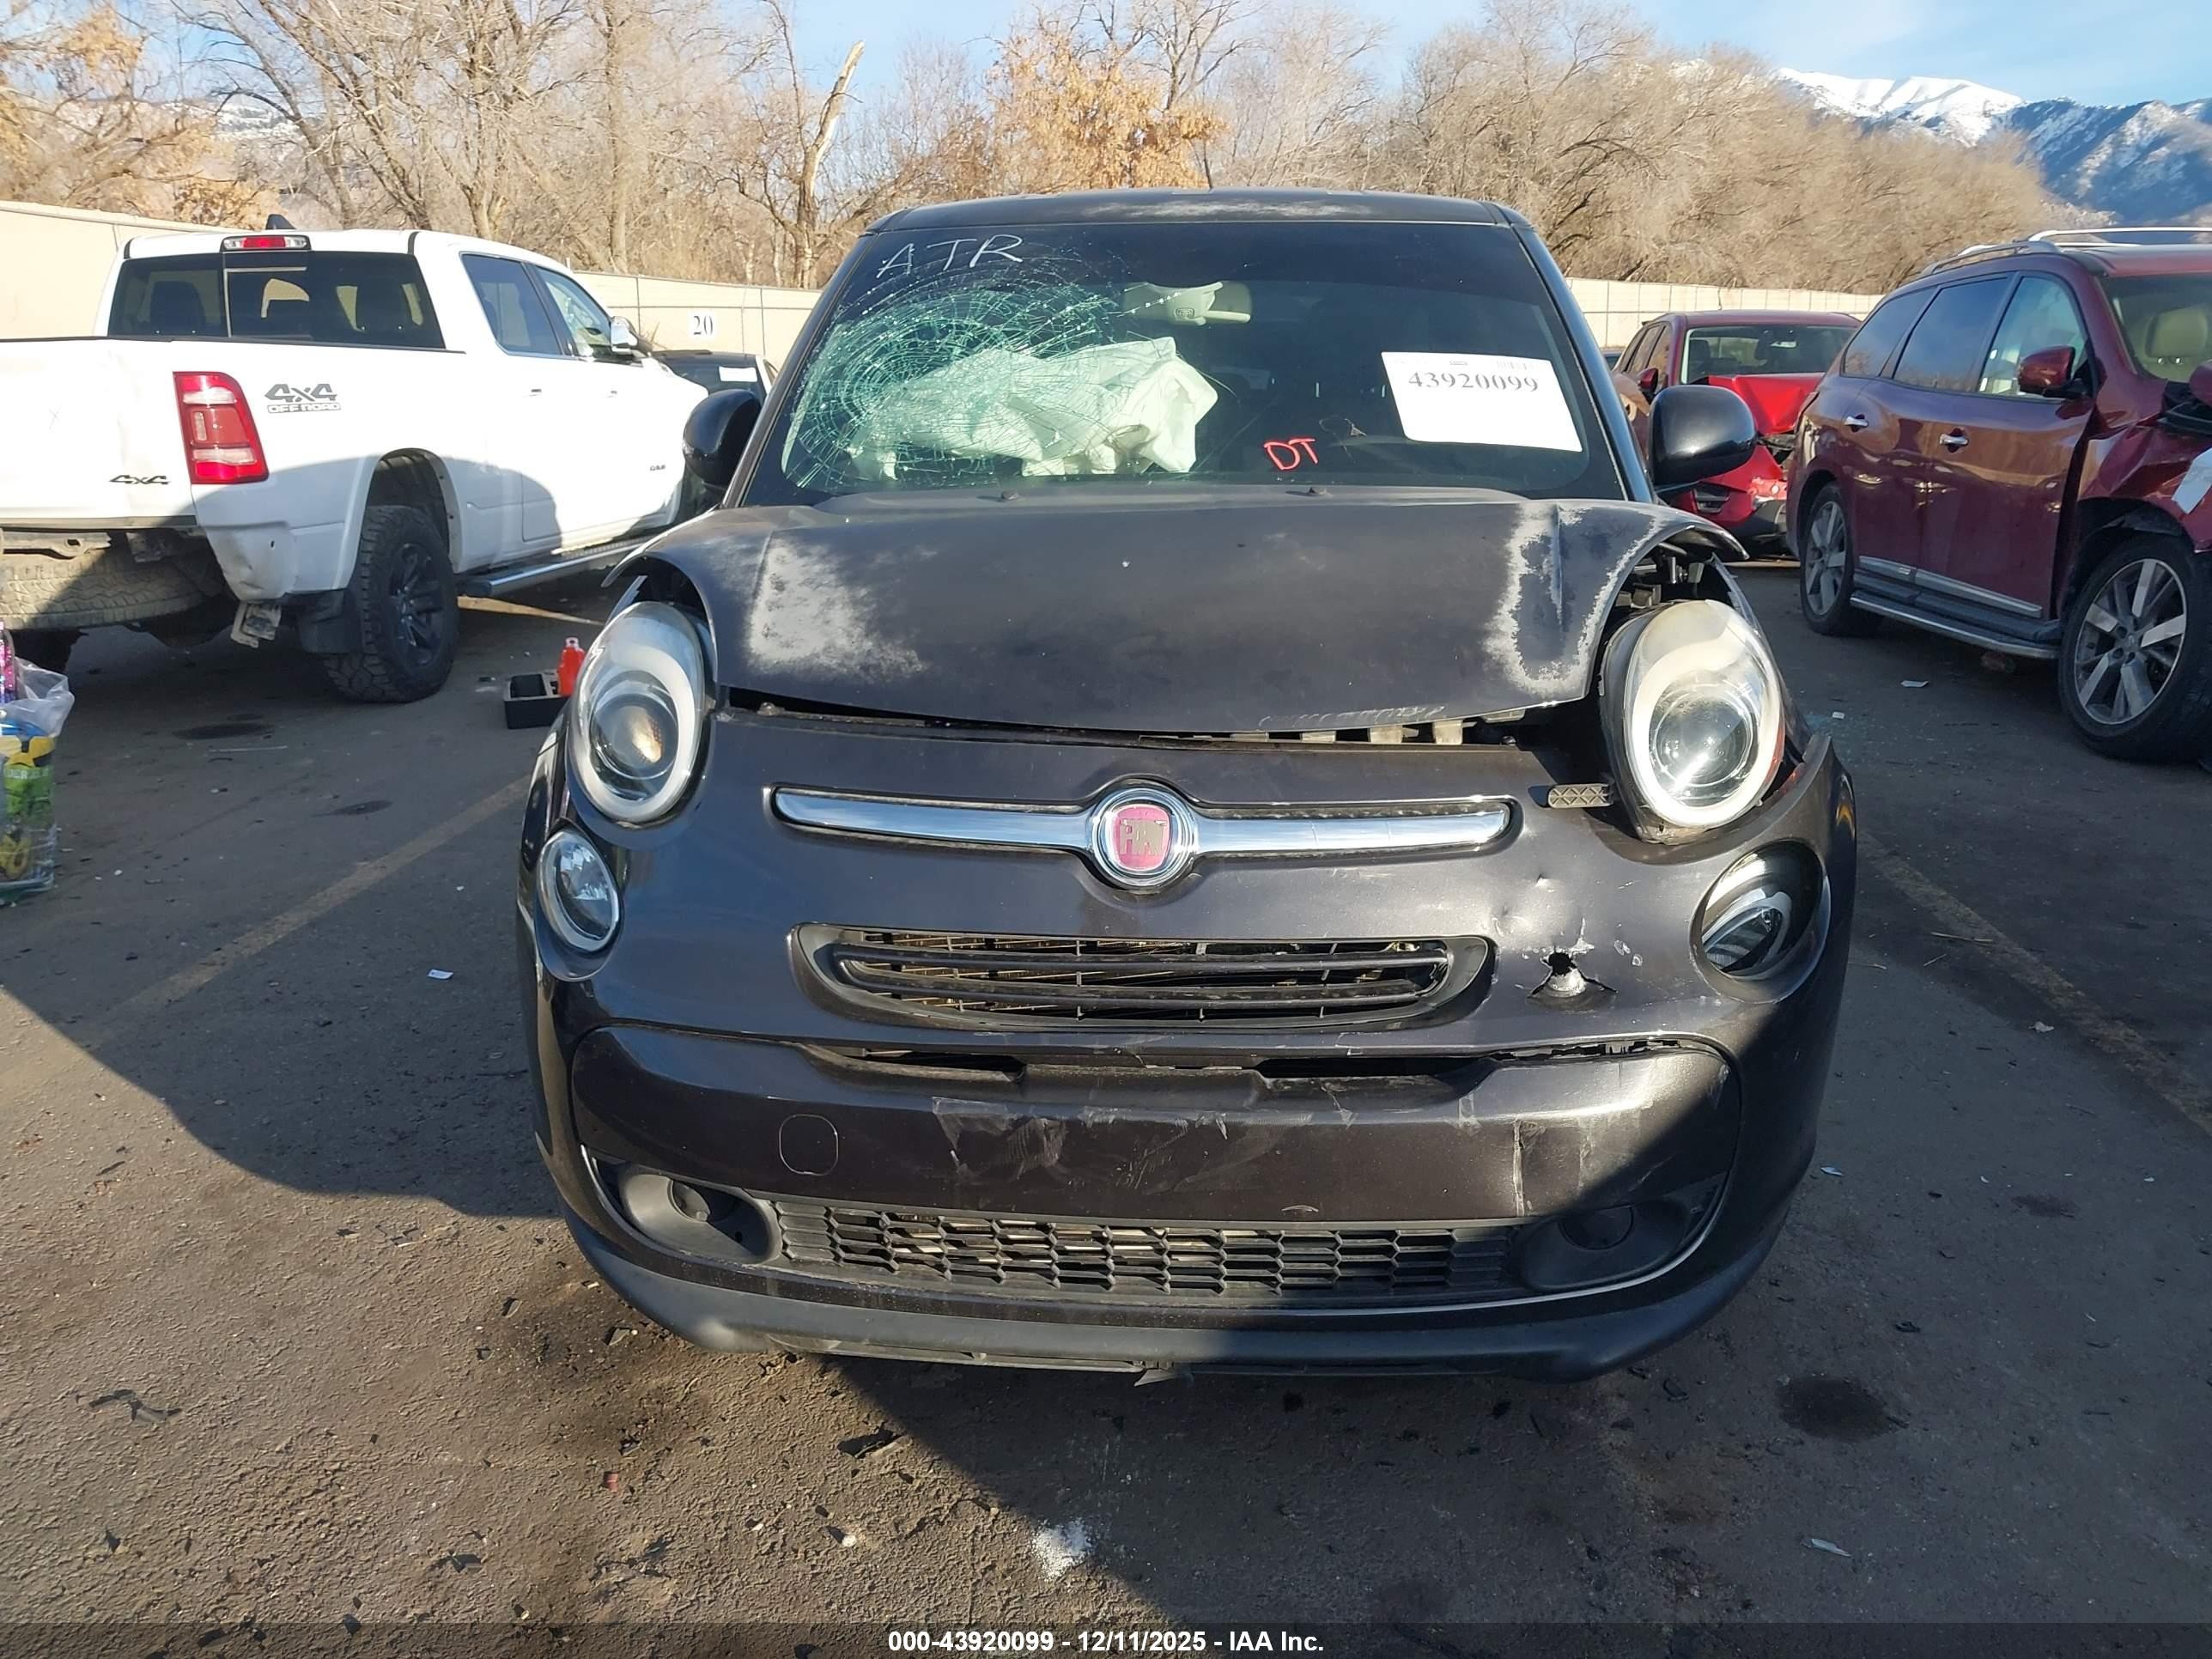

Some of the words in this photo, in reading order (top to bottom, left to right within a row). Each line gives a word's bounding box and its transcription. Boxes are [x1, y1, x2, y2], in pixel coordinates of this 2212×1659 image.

[876, 234, 1023, 278] ATR
[693, 315, 714, 336] 20
[1408, 371, 1539, 392] 43920099
[1263, 437, 1319, 471] DT
